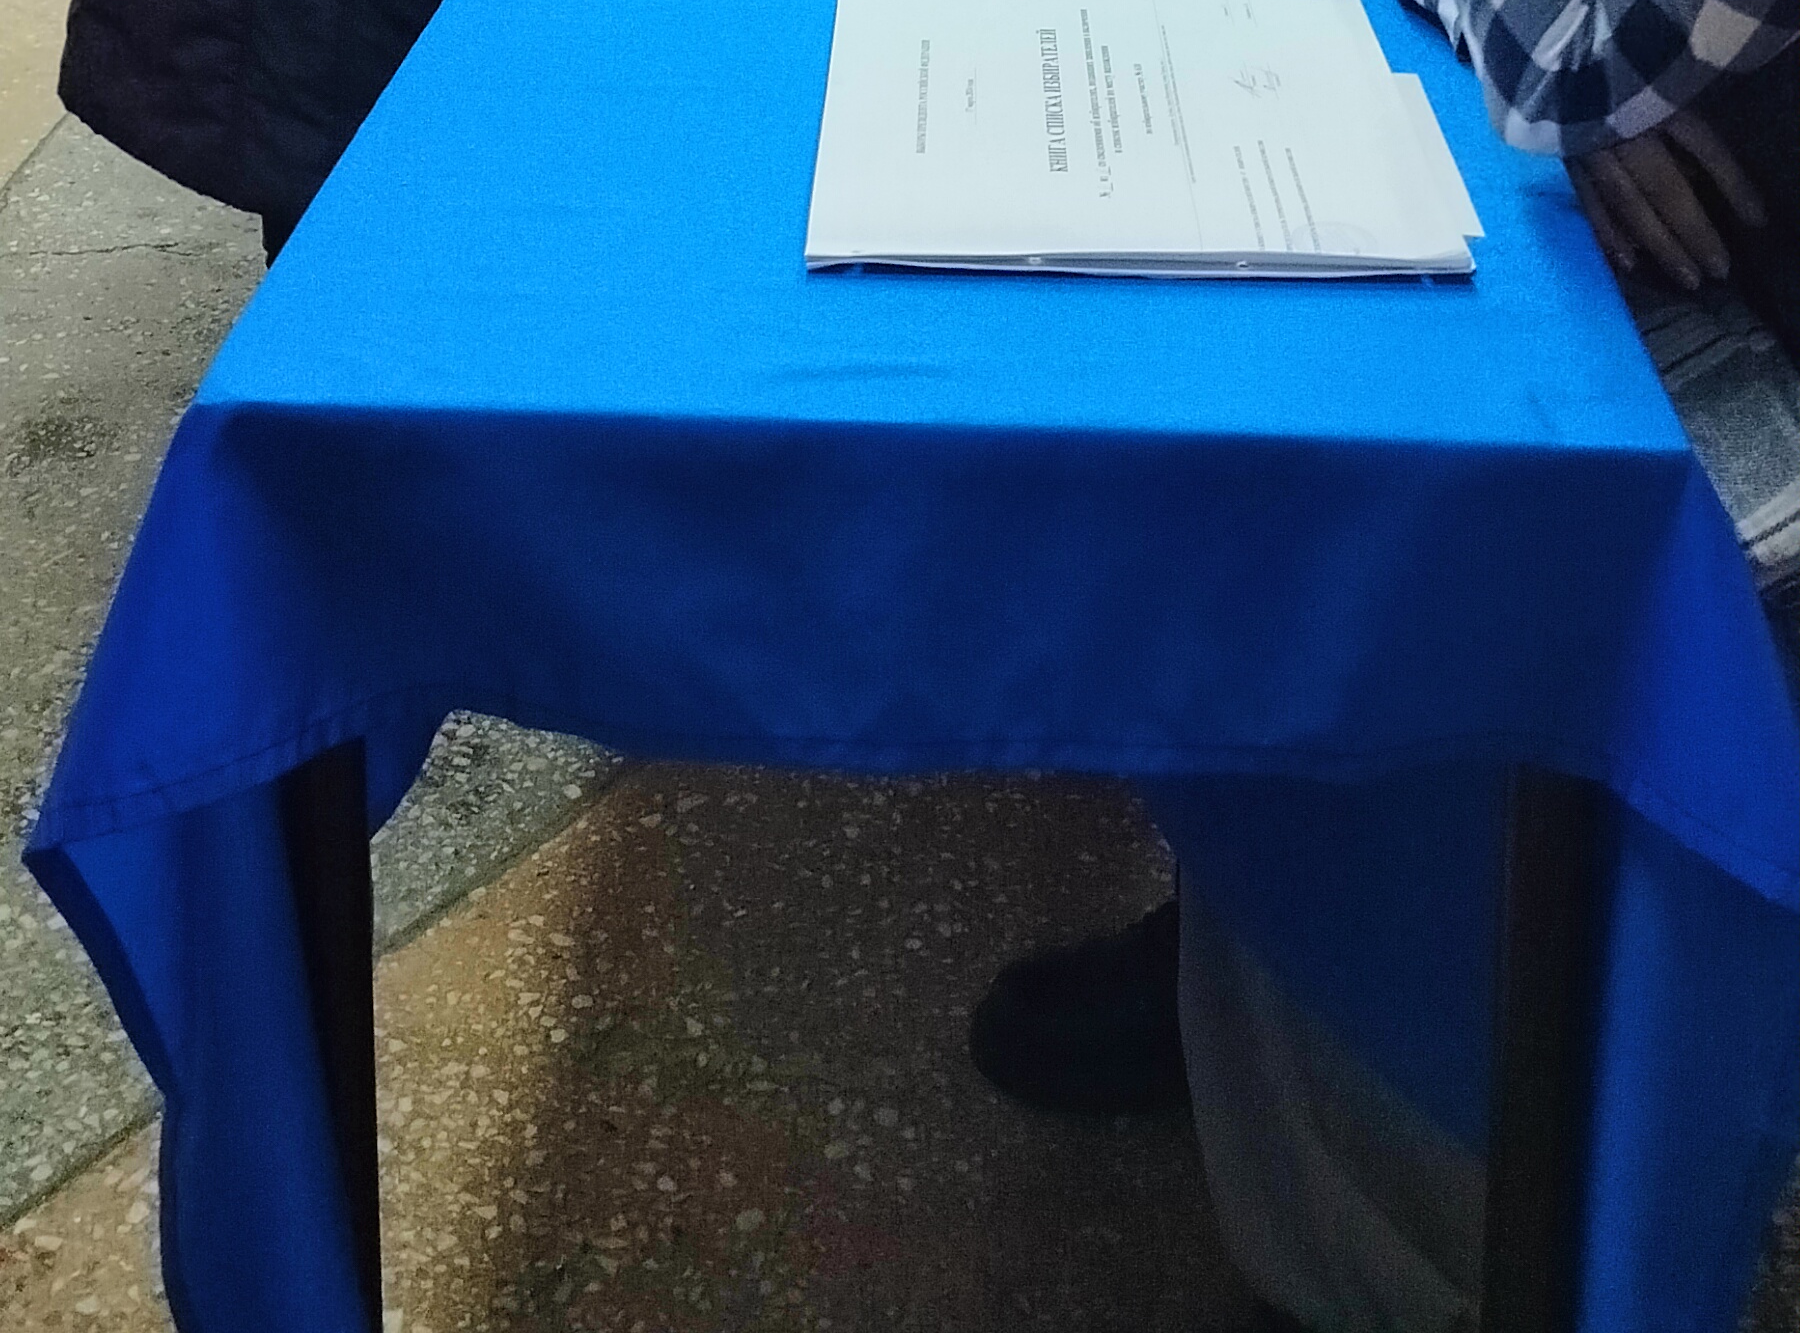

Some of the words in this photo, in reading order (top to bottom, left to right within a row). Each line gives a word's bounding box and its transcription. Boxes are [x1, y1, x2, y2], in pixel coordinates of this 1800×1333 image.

[1036, 28, 1062, 93] ИЗБИРАТЕЛЕЙ
[1045, 94, 1065, 136] СПИСКА
[1048, 137, 1068, 173] КНИГА
